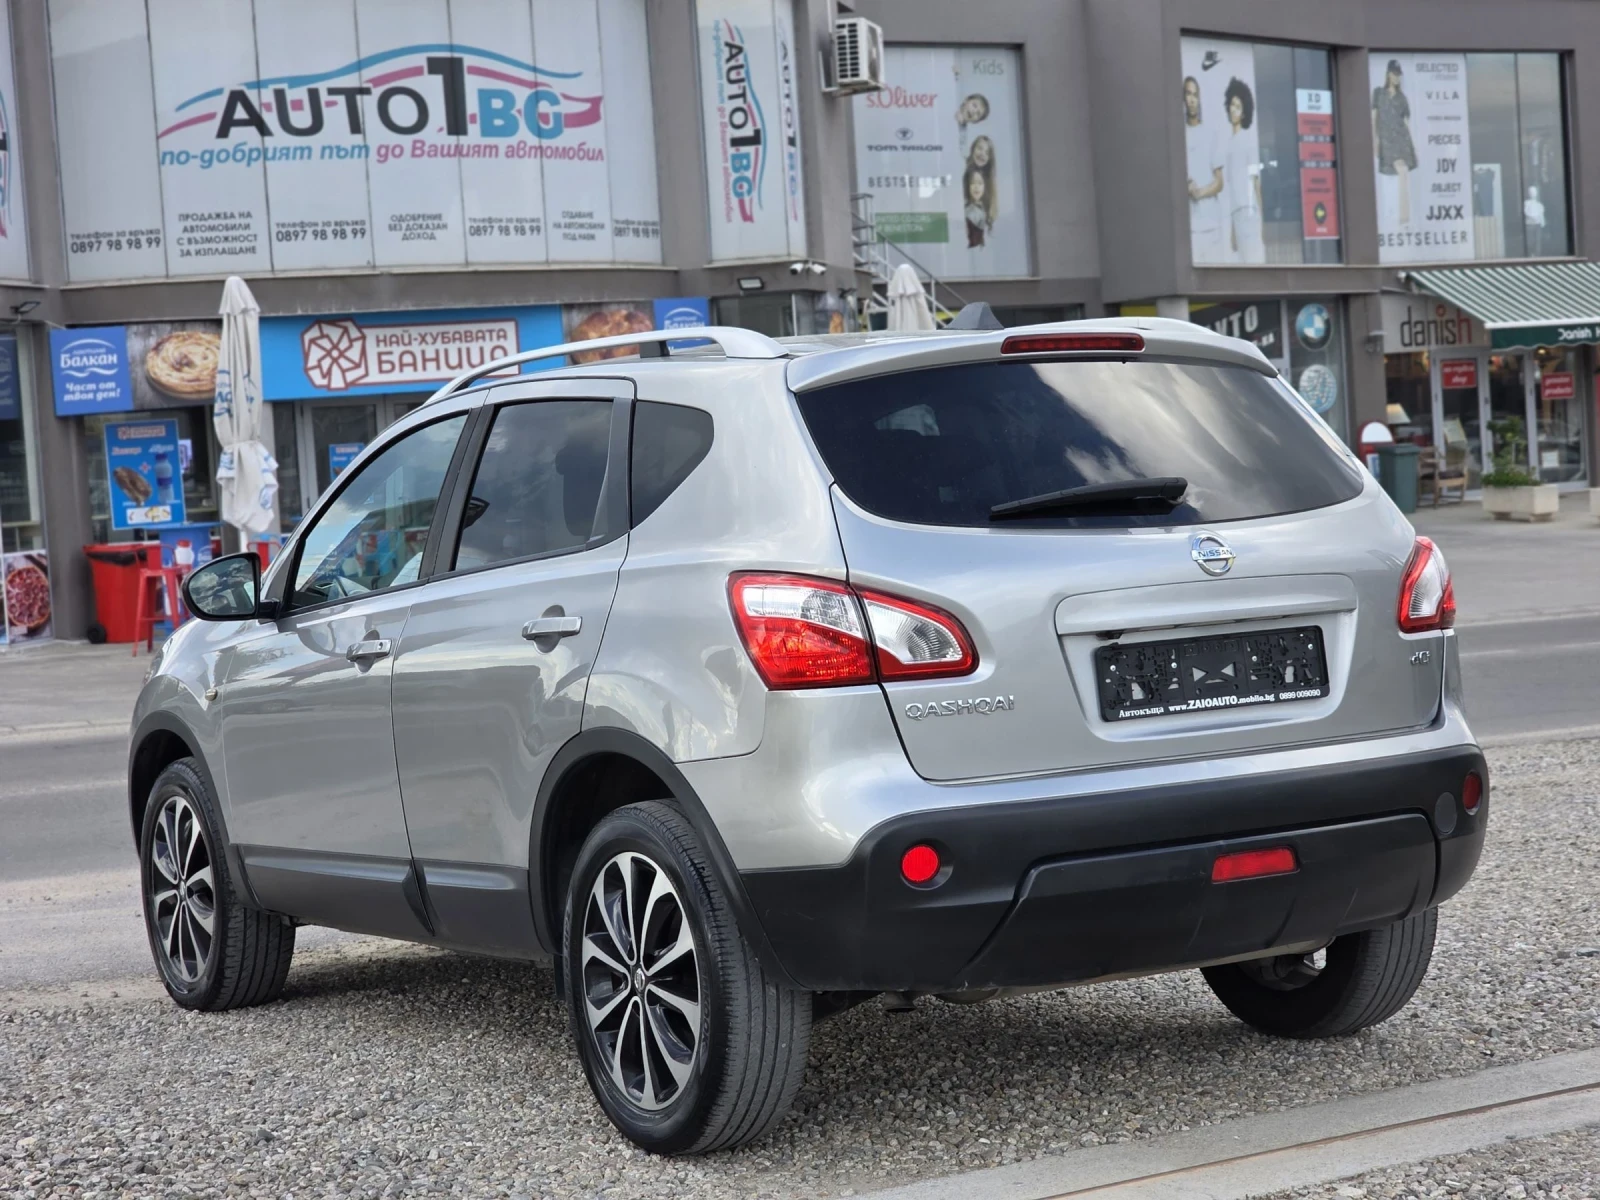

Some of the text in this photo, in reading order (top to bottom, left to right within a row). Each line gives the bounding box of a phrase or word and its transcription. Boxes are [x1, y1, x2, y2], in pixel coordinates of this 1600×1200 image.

[972, 59, 1004, 76] Kids
[1415, 63, 1459, 73] SELECTED
[866, 86, 938, 108] s.Oliver
[1425, 91, 1460, 100] VILA
[1428, 134, 1462, 145] PIECES
[160, 140, 604, 169] по-добрият път до Вашият автомобил
[1436, 158, 1457, 174] JDY
[868, 176, 948, 189] BESTSELER
[178, 211, 252, 223] ПРОДАЖБА НА
[390, 213, 443, 222] ОДОБРЕНИЕ
[1426, 204, 1464, 221] JJXX
[182, 223, 251, 234] АВТОМОБИЛИ
[275, 221, 319, 230] телефон
[334, 219, 366, 229] връзка
[388, 222, 448, 232] БЕЗ ДОКАЗАН
[469, 225, 541, 236] 0897 98 98 99
[176, 233, 258, 246] С ВЪЗМОЖНОСТ
[276, 227, 366, 242] 0897 98 98 99
[401, 232, 437, 241] ДОХОД
[1378, 230, 1468, 247] BESTSELLER
[70, 236, 161, 254] 0897 98 98 99
[179, 246, 257, 258] ЗА ИЗПЛАЩАНЕ
[1400, 304, 1472, 348] danish
[375, 327, 508, 348] НАЙ-ХУБАВАТА
[60, 353, 118, 368] Балкан
[98, 381, 116, 389] от
[1197, 549, 1233, 558] NISSAN
[904, 695, 1015, 721] QASHQAI
[1118, 706, 1165, 718] Автокъща
